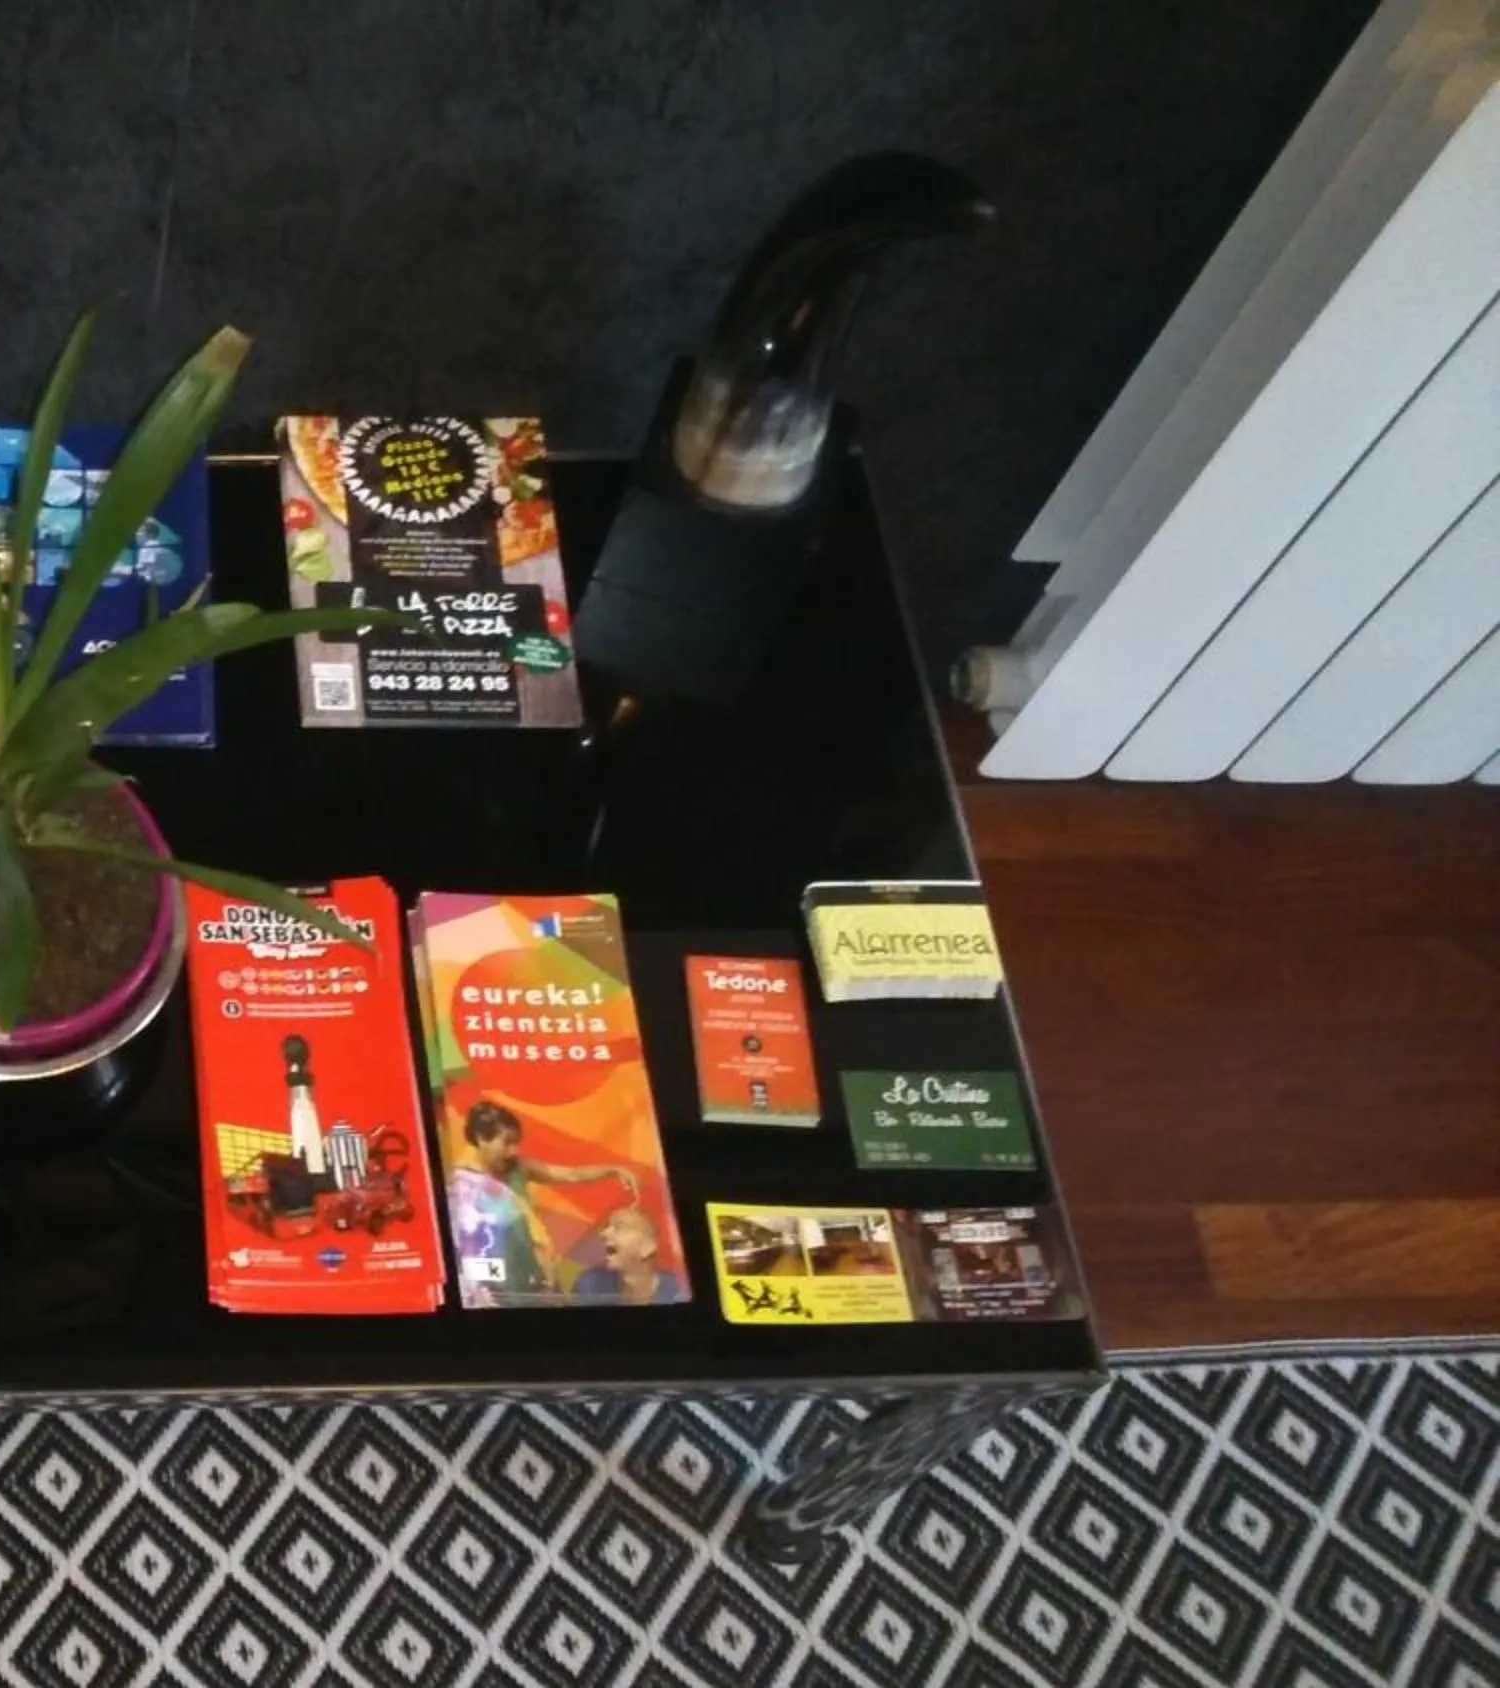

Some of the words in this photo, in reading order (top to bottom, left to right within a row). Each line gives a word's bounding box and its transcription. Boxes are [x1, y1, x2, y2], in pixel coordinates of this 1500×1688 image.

[387, 440, 434, 453] Pizza
[397, 591, 428, 614] LA
[443, 615, 513, 637] PIZZA
[368, 675, 410, 691] 943
[415, 675, 443, 691] 28
[448, 676, 476, 691] 24
[481, 676, 509, 691] 95
[201, 923, 244, 941] SAN
[703, 969, 788, 994] Tedone
[461, 984, 605, 1007] eureka!
[464, 1012, 609, 1035] zientzia
[467, 1042, 612, 1062] museoa
